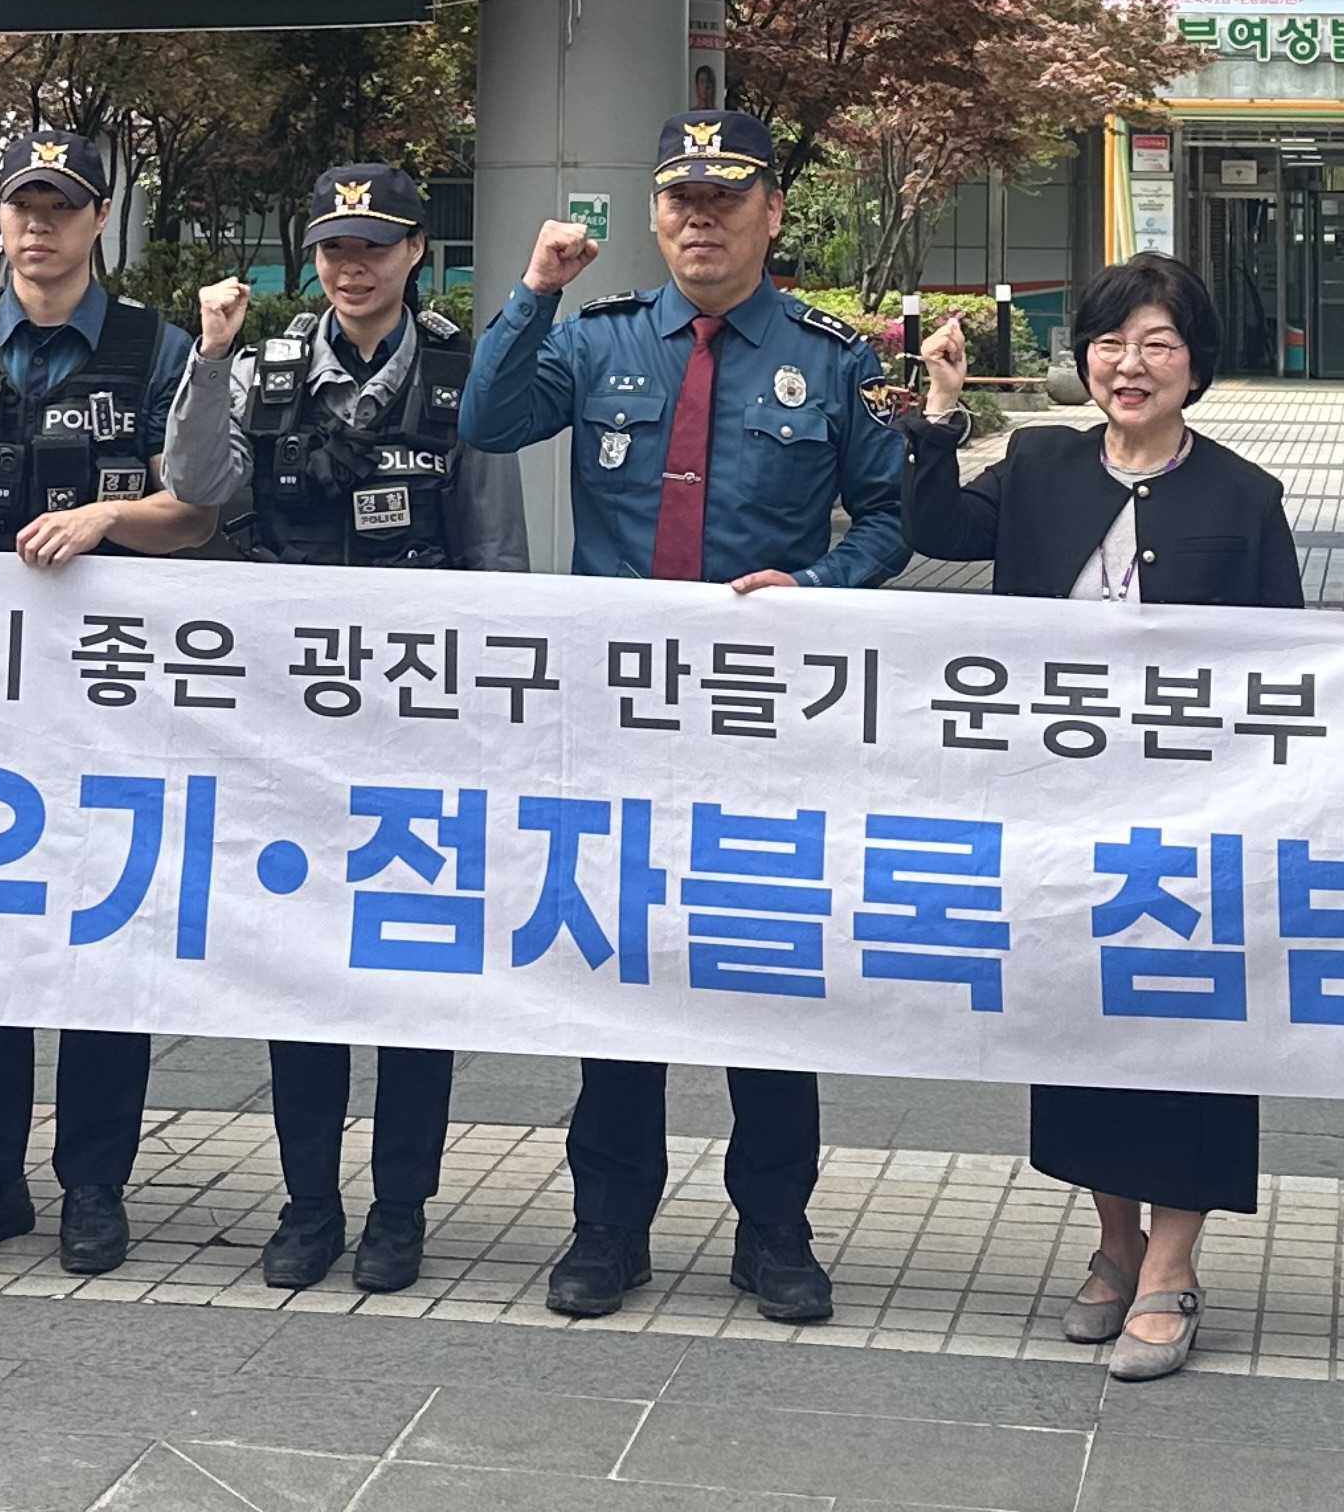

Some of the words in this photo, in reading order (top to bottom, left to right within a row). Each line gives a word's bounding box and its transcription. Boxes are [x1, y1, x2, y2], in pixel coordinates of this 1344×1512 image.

[377, 450, 446, 473] OLICE
[106, 473, 143, 491] 경찰
[359, 492, 403, 513] 경찰
[361, 513, 405, 525] POLICE
[72, 615, 248, 710] 좋은
[289, 626, 561, 725] 광진구
[608, 639, 880, 746] 만들기
[931, 656, 1328, 766] 운동본부
